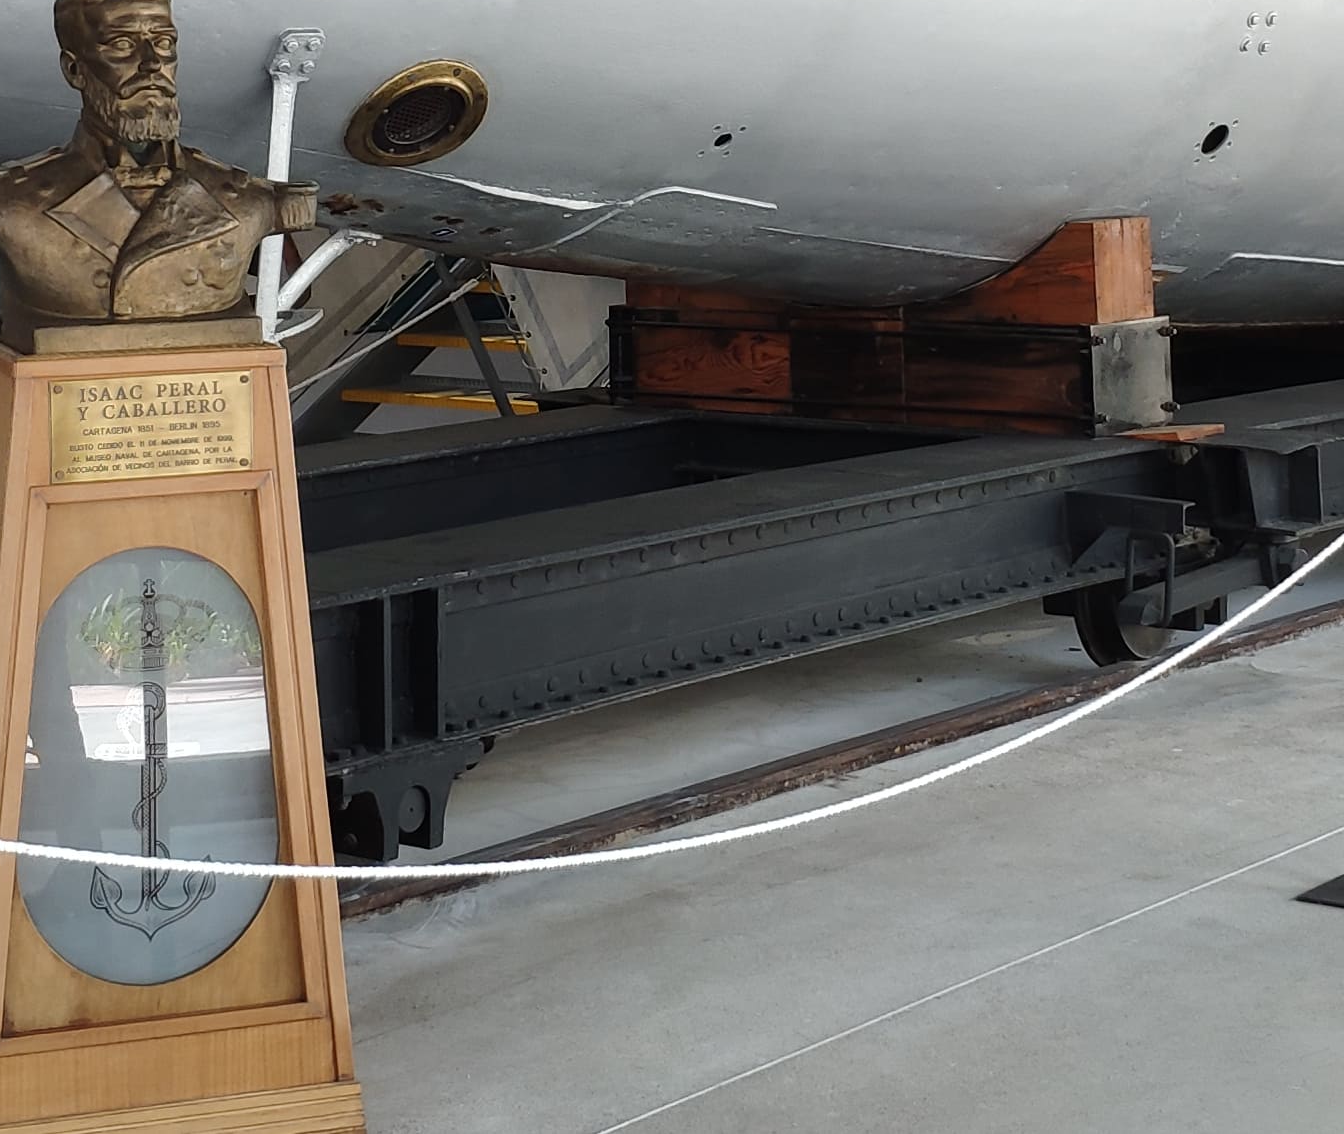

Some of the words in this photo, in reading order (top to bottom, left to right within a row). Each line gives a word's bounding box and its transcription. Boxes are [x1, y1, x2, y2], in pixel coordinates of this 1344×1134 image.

[79, 384, 143, 404] ISAAC
[156, 380, 223, 398] PERAL
[77, 406, 88, 421] Y
[102, 398, 226, 420] CABALLERO
[82, 426, 133, 436] CARTAGENA
[169, 422, 198, 431] BERLIN
